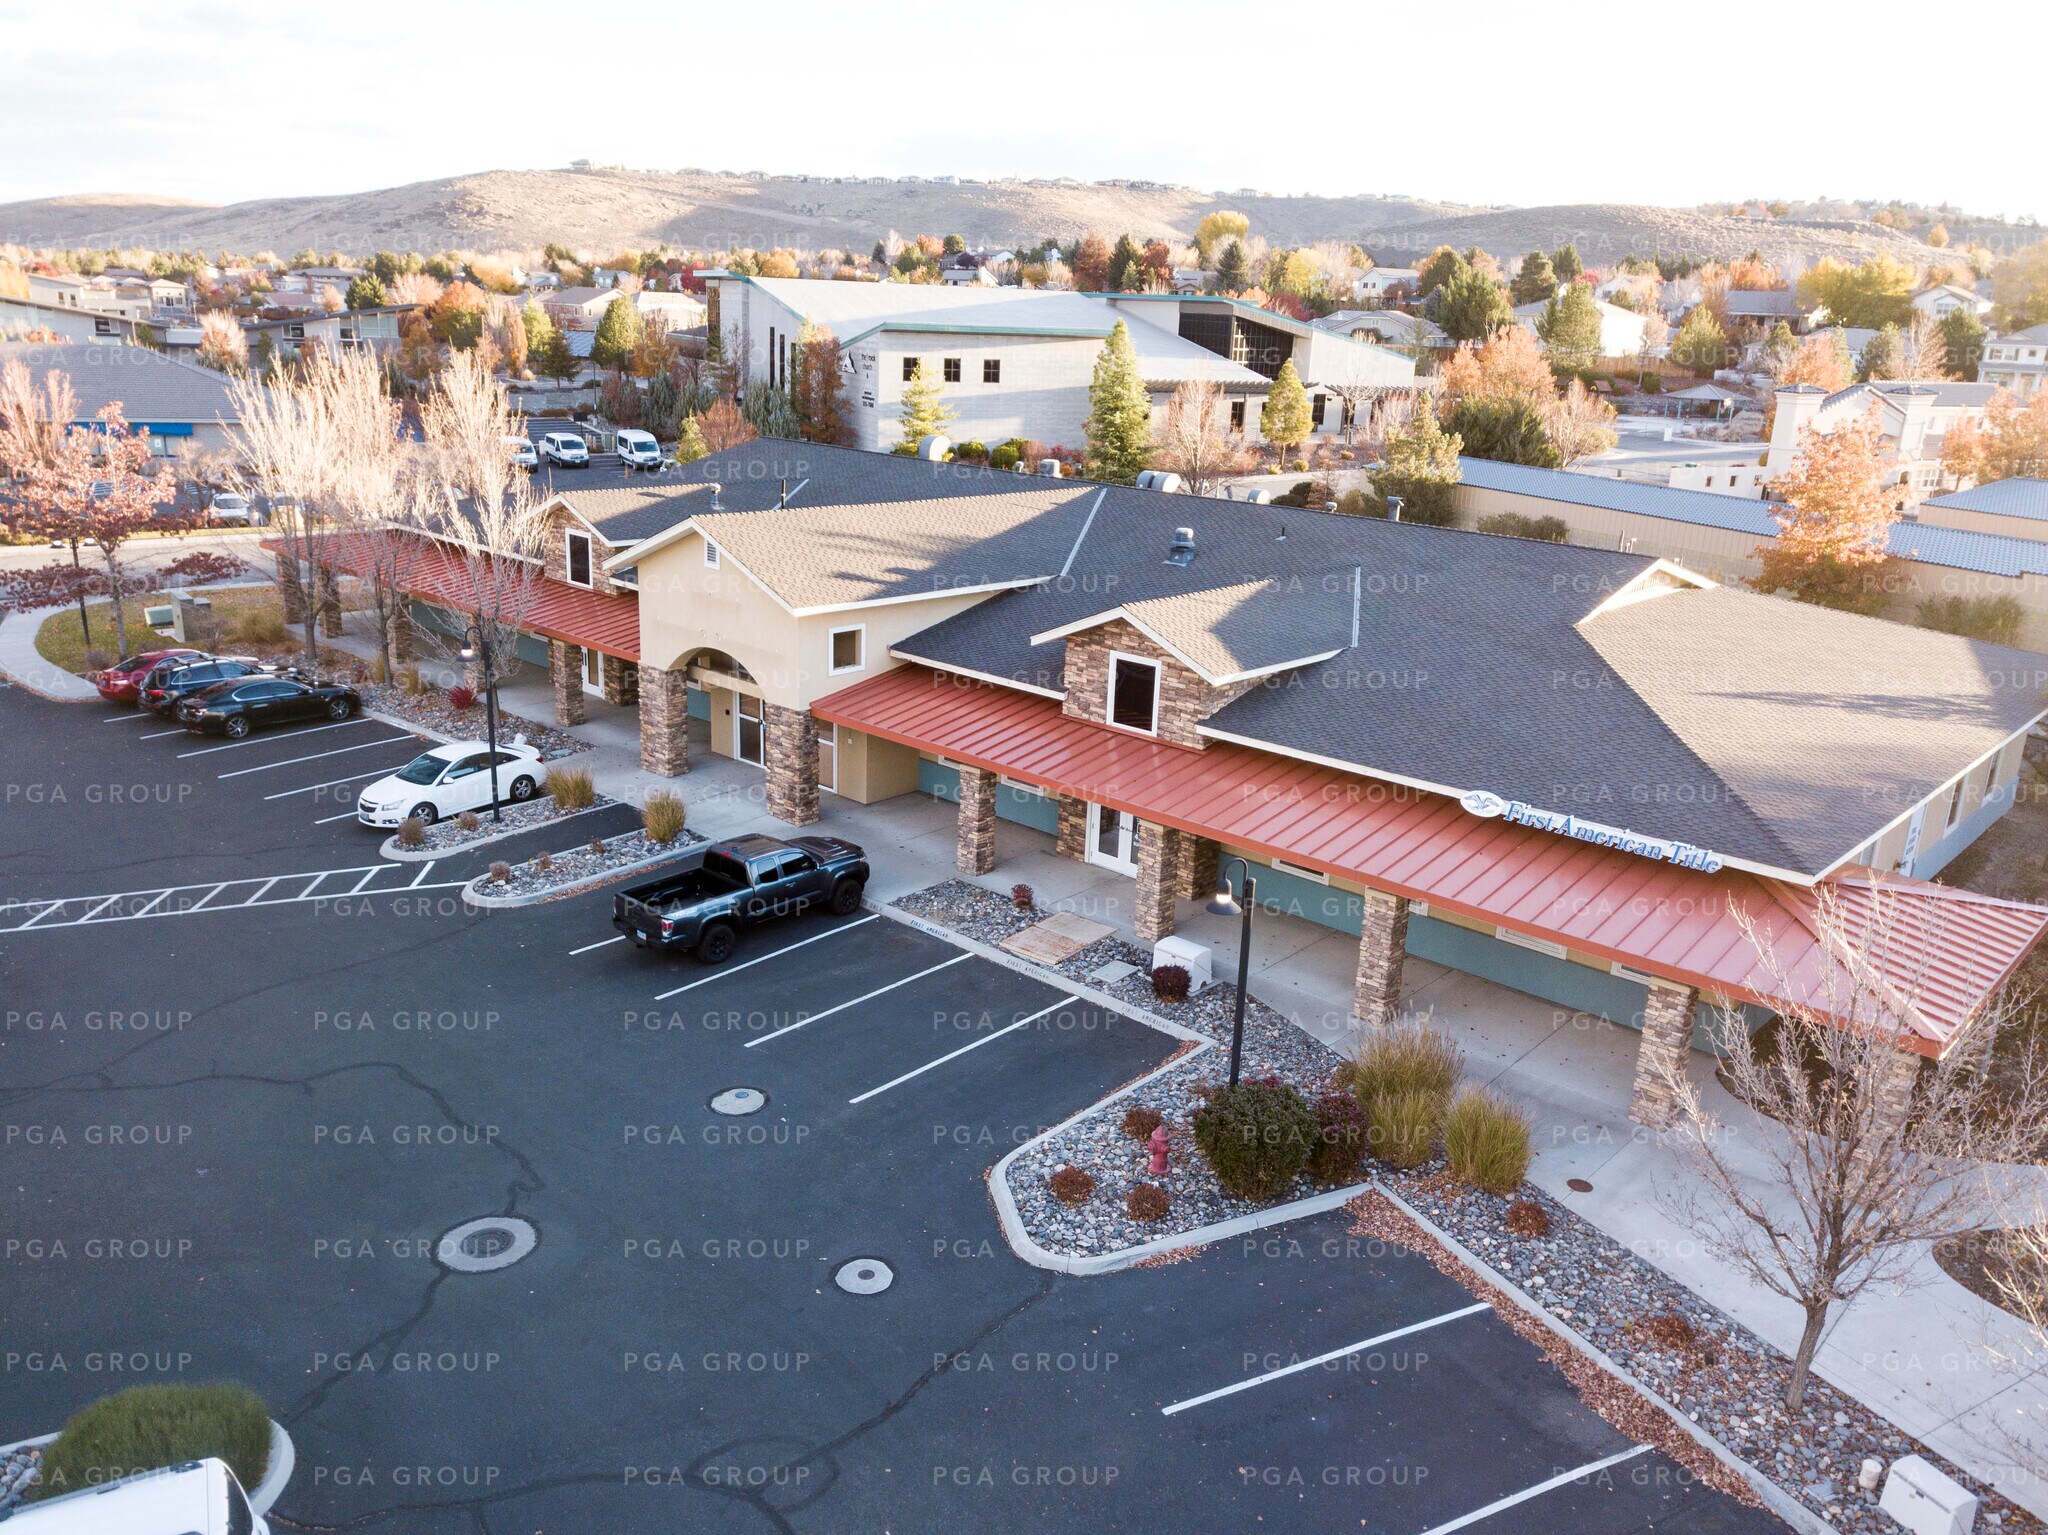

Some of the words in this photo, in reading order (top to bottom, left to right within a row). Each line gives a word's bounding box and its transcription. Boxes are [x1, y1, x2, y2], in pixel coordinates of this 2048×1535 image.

[1503, 801, 1553, 831] First
[1555, 815, 1663, 860] American
[1666, 841, 1720, 874] Title
[910, 919, 924, 929] FIRST
[926, 926, 949, 939] AMERICAN
[1006, 959, 1022, 969] FIRST
[1025, 967, 1049, 980] AMERICAN
[1141, 1014, 1170, 1030] AMERICAN
